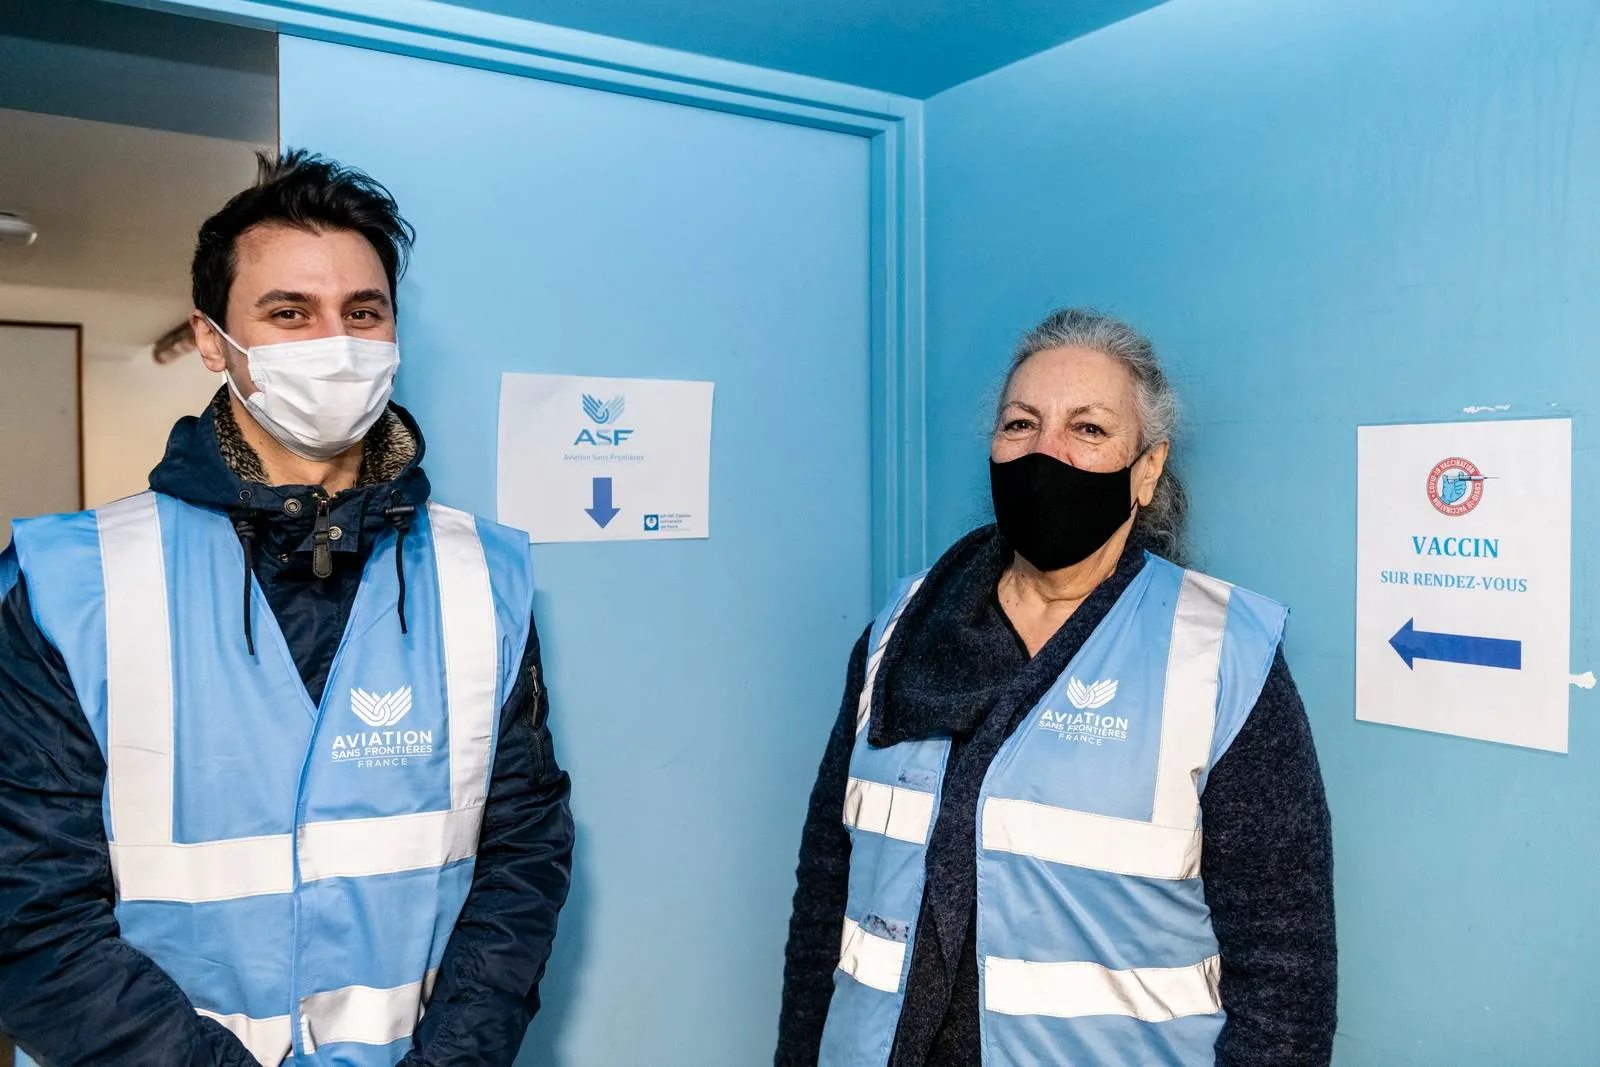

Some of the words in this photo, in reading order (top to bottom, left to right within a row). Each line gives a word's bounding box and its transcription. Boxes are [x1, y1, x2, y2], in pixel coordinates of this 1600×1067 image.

[573, 428, 634, 446] ASF
[1428, 467, 1441, 494] COVID-19
[1440, 459, 1476, 474] VACCINATION
[1466, 482, 1482, 509] COVID-19
[1412, 536, 1499, 558] VACCIN
[1380, 570, 1409, 585] SUR
[1414, 572, 1528, 592] RENDEZ-VOUS
[1039, 720, 1064, 731] SANS
[1041, 710, 1129, 730] AVIATION
[332, 730, 433, 750] AVIATION
[1058, 733, 1102, 746] FRANCE
[332, 748, 360, 759] SANS
[358, 758, 408, 768] FRANCE
